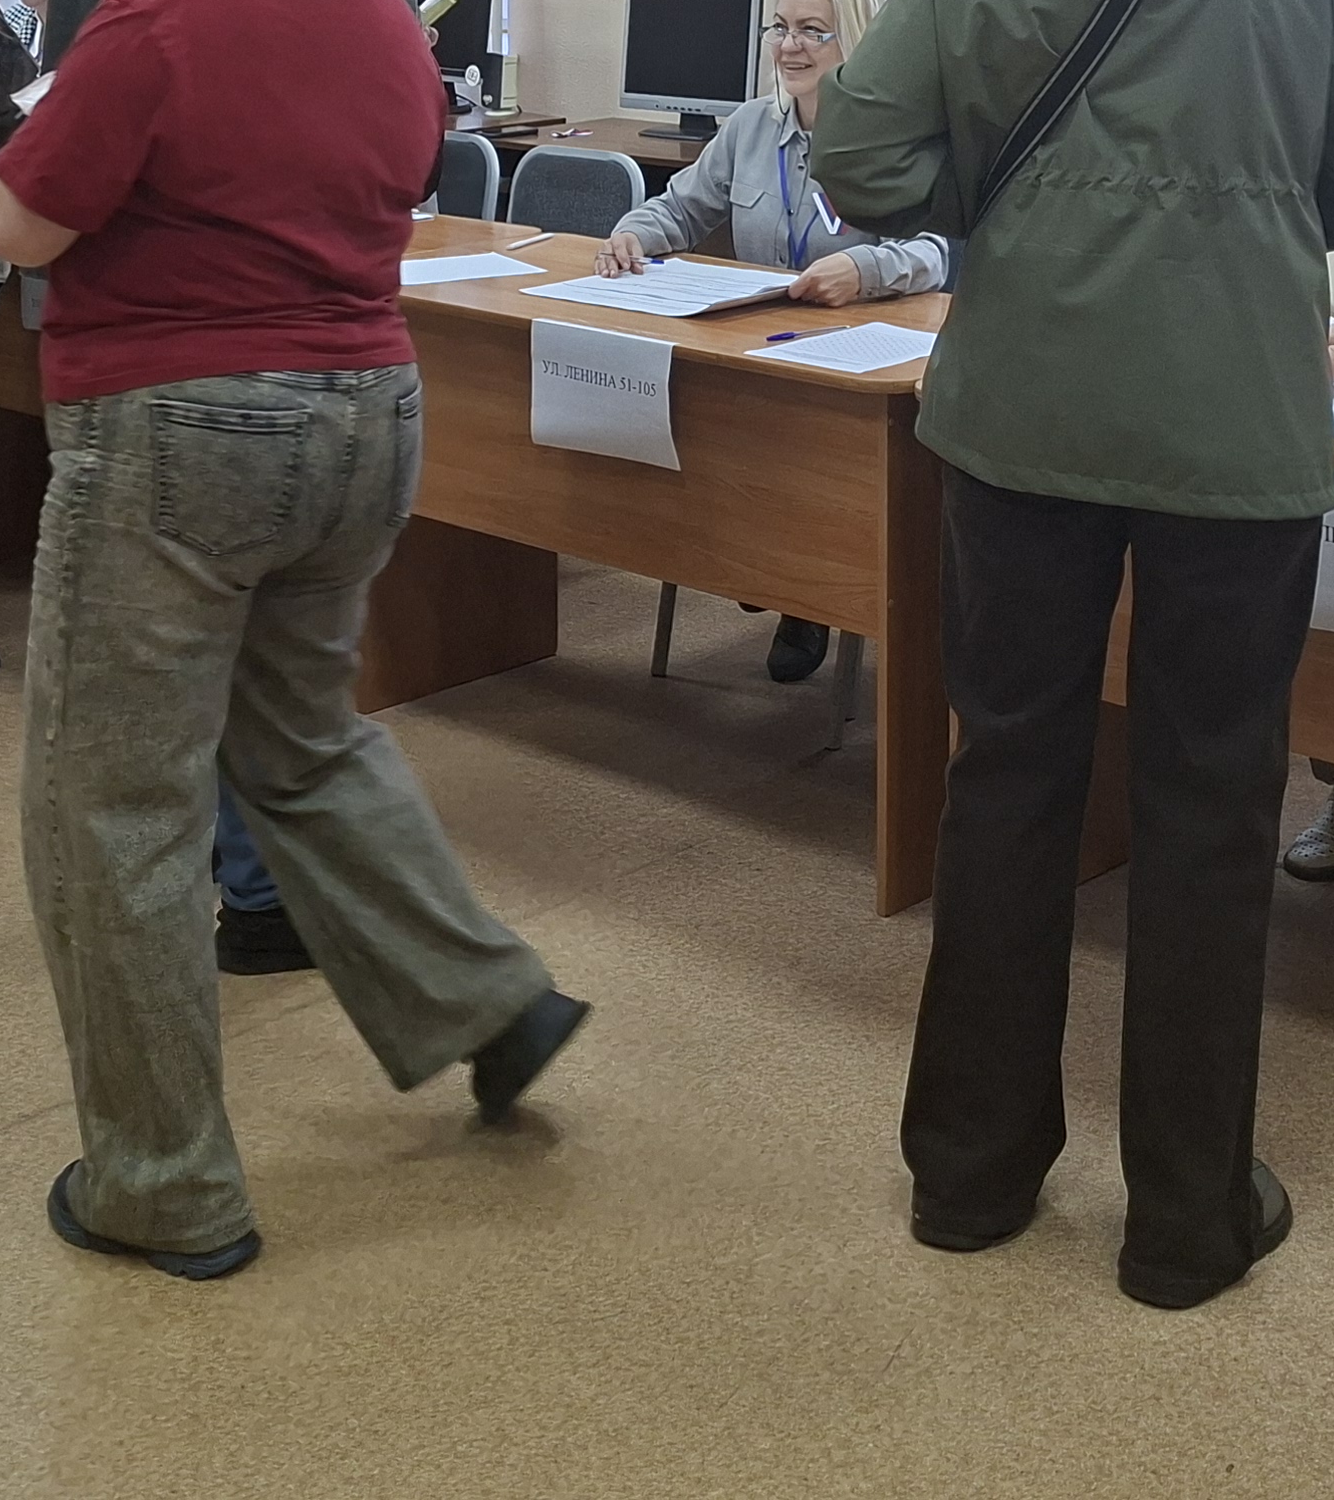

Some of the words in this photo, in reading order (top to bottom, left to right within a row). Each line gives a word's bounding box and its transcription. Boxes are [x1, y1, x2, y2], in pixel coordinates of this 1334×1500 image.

[542, 359, 562, 377] УЛ.
[564, 364, 617, 389] ЛЕНИНА
[618, 377, 657, 397] 51-105
